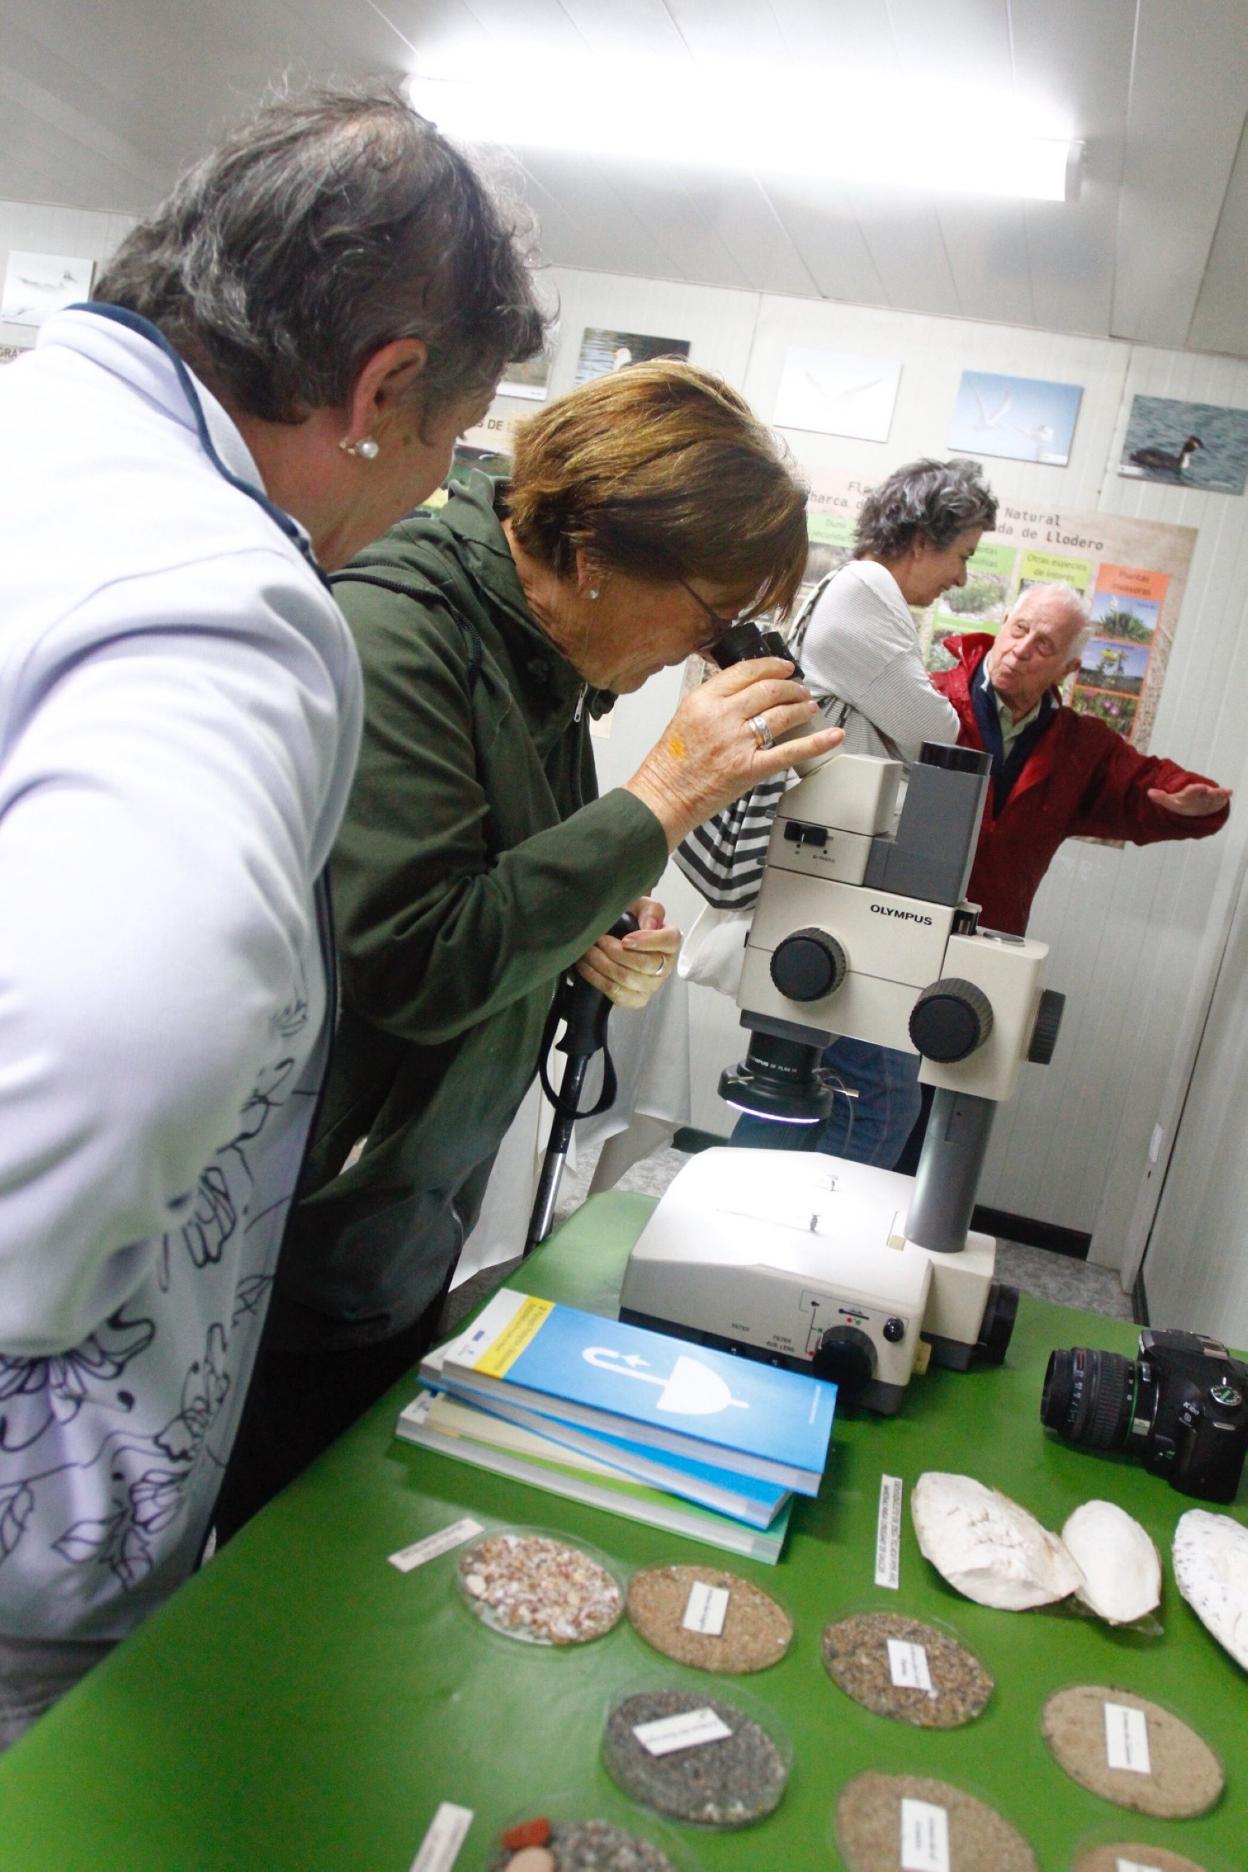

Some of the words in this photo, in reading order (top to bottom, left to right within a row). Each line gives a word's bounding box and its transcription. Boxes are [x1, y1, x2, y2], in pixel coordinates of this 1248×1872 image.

[487, 419, 504, 430] DE
[1005, 507, 1061, 527] Natural
[997, 522, 1014, 536] da
[1021, 527, 1039, 540] de
[1046, 530, 1104, 551] Llodero
[870, 904, 933, 926] OLYMPUS
